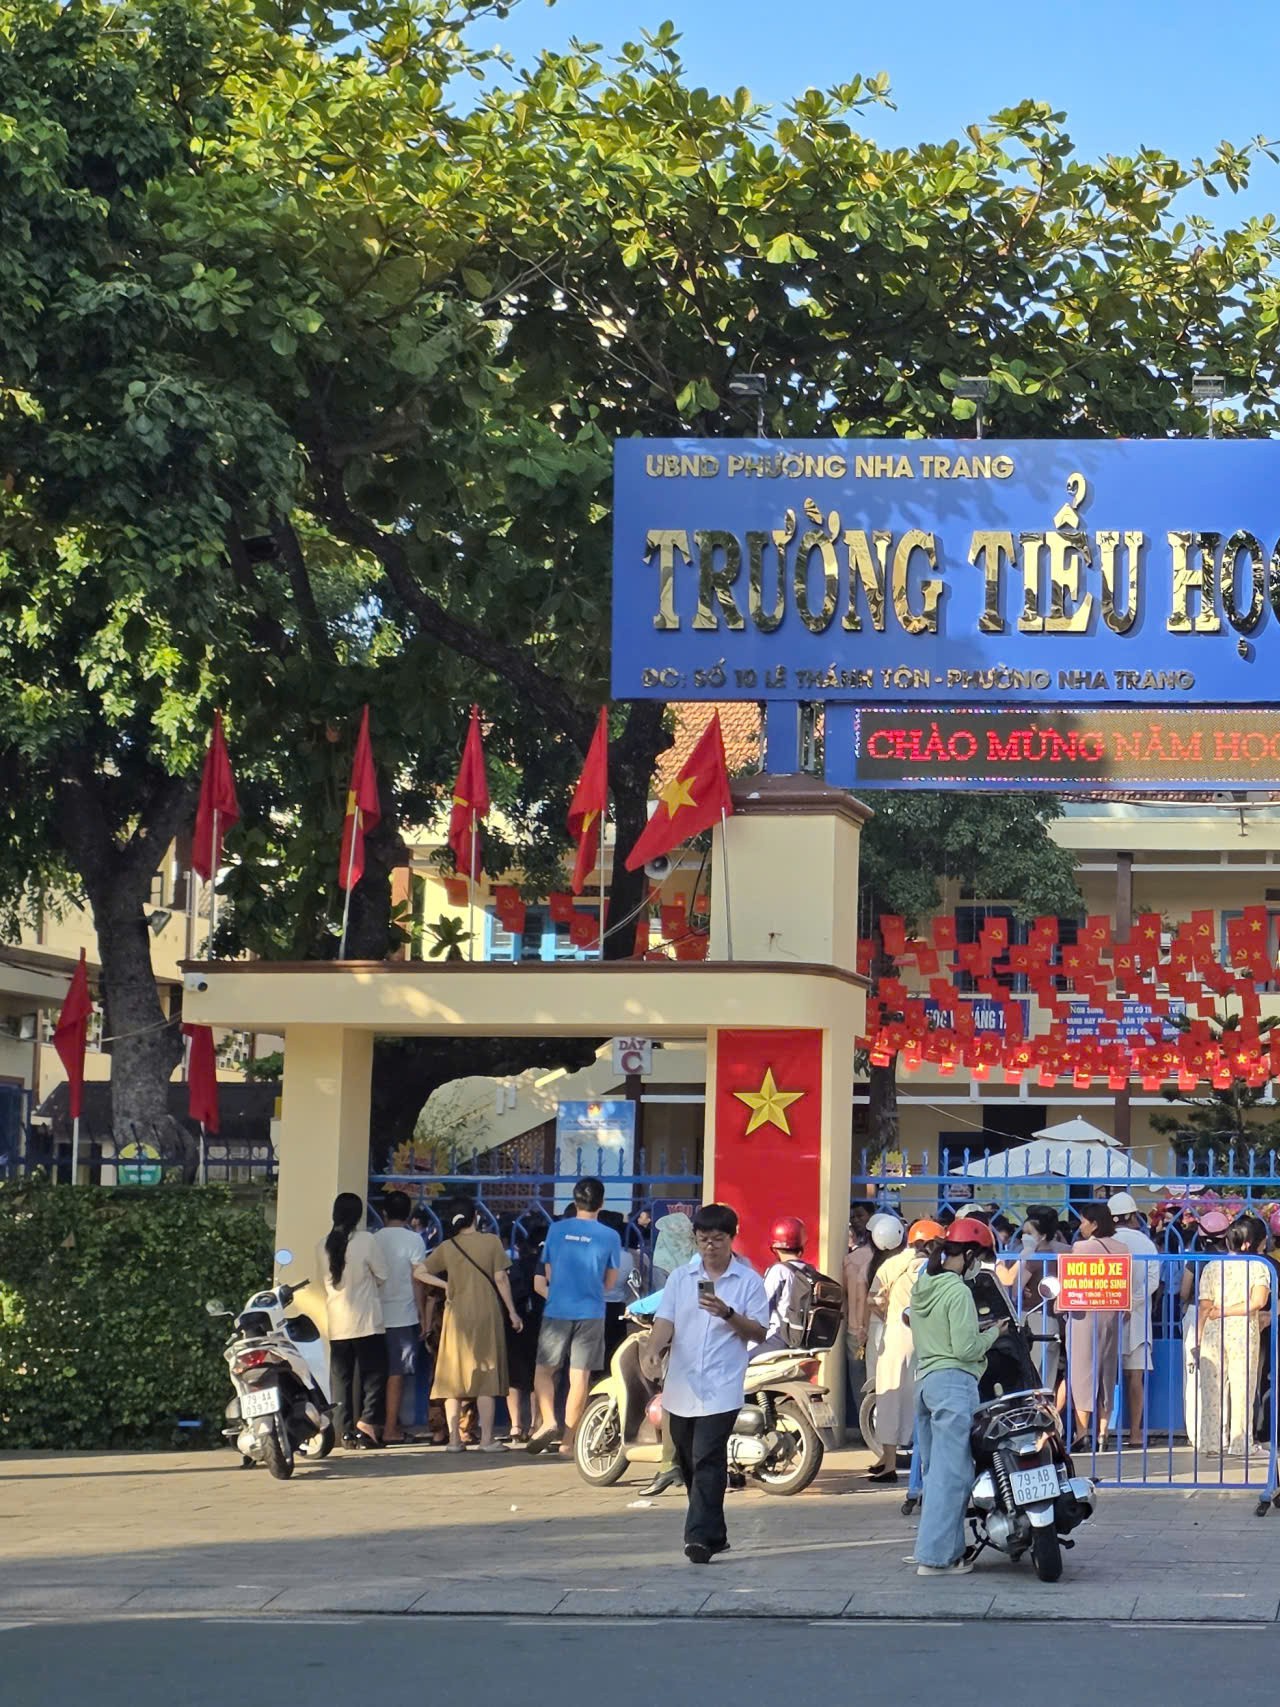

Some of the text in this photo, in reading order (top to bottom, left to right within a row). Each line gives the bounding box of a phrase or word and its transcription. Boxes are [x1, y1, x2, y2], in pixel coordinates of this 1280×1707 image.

[646, 449, 1015, 479] UBND PHƯỜNG NHA TRANG
[643, 495, 945, 635] TRƯỜNG
[967, 471, 1140, 636] TIỂU
[694, 656, 727, 689] SỐ
[735, 669, 758, 688] 10
[765, 663, 787, 688] LÊ
[795, 661, 874, 689] THÁNH
[881, 664, 930, 689] TÔN
[947, 662, 1051, 690] PHƯỜNG
[1058, 669, 1109, 690] NHA
[1113, 669, 1196, 690] TRANG
[867, 722, 978, 761] CHÀO
[986, 723, 1105, 762] MỪNG
[1113, 722, 1204, 762] NĂM
[621, 1051, 643, 1074] C
[1067, 1261, 1087, 1276] NƠI
[1108, 1262, 1123, 1276] XE
[1094, 1279, 1109, 1290] HỌC
[1110, 1279, 1127, 1289] SINH
